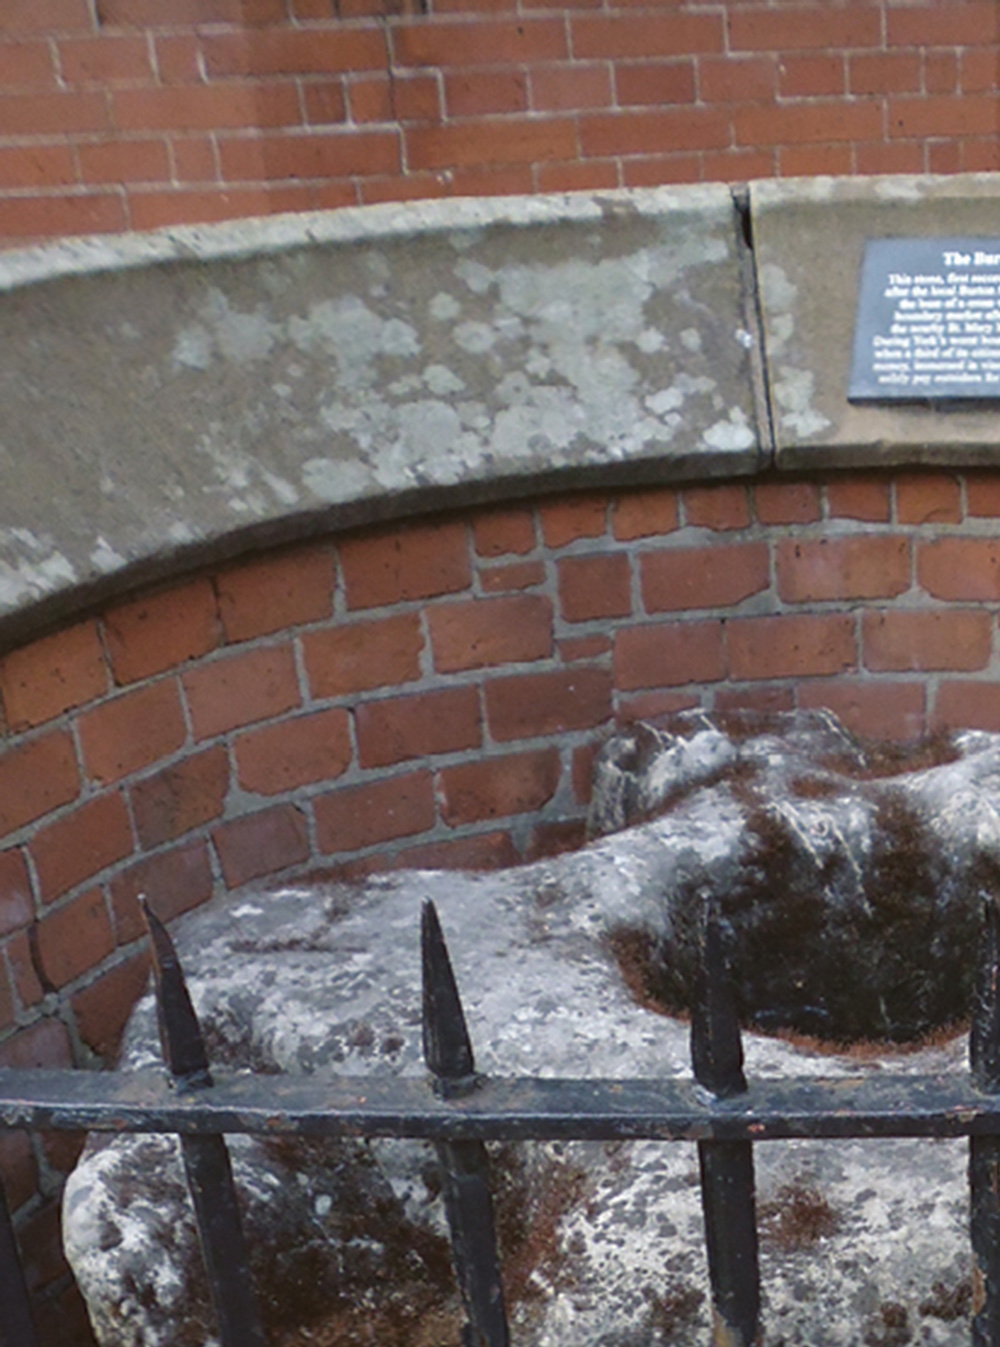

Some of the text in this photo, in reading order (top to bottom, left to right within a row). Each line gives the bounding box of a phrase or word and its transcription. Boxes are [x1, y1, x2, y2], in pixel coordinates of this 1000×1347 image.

[943, 252, 971, 266] The
[889, 274, 911, 284] This
[947, 273, 968, 283] first
[884, 286, 909, 296] after
[912, 286, 927, 296] the
[931, 286, 956, 296] local
[959, 286, 995, 296] Burton
[899, 299, 915, 309] the
[919, 299, 941, 308] base
[945, 298, 957, 308] of
[959, 300, 964, 308] a
[894, 311, 942, 322] boundary
[891, 324, 906, 333] the
[910, 324, 944, 335] nearby
[965, 323, 992, 334] Mary
[873, 335, 909, 347] During
[874, 349, 902, 358] when
[905, 350, 911, 358] a
[914, 348, 940, 358] third
[942, 348, 954, 358] of
[956, 349, 968, 357] its
[968, 362, 977, 370] in
[912, 375, 931, 385] pay
[985, 373, 999, 382] for
